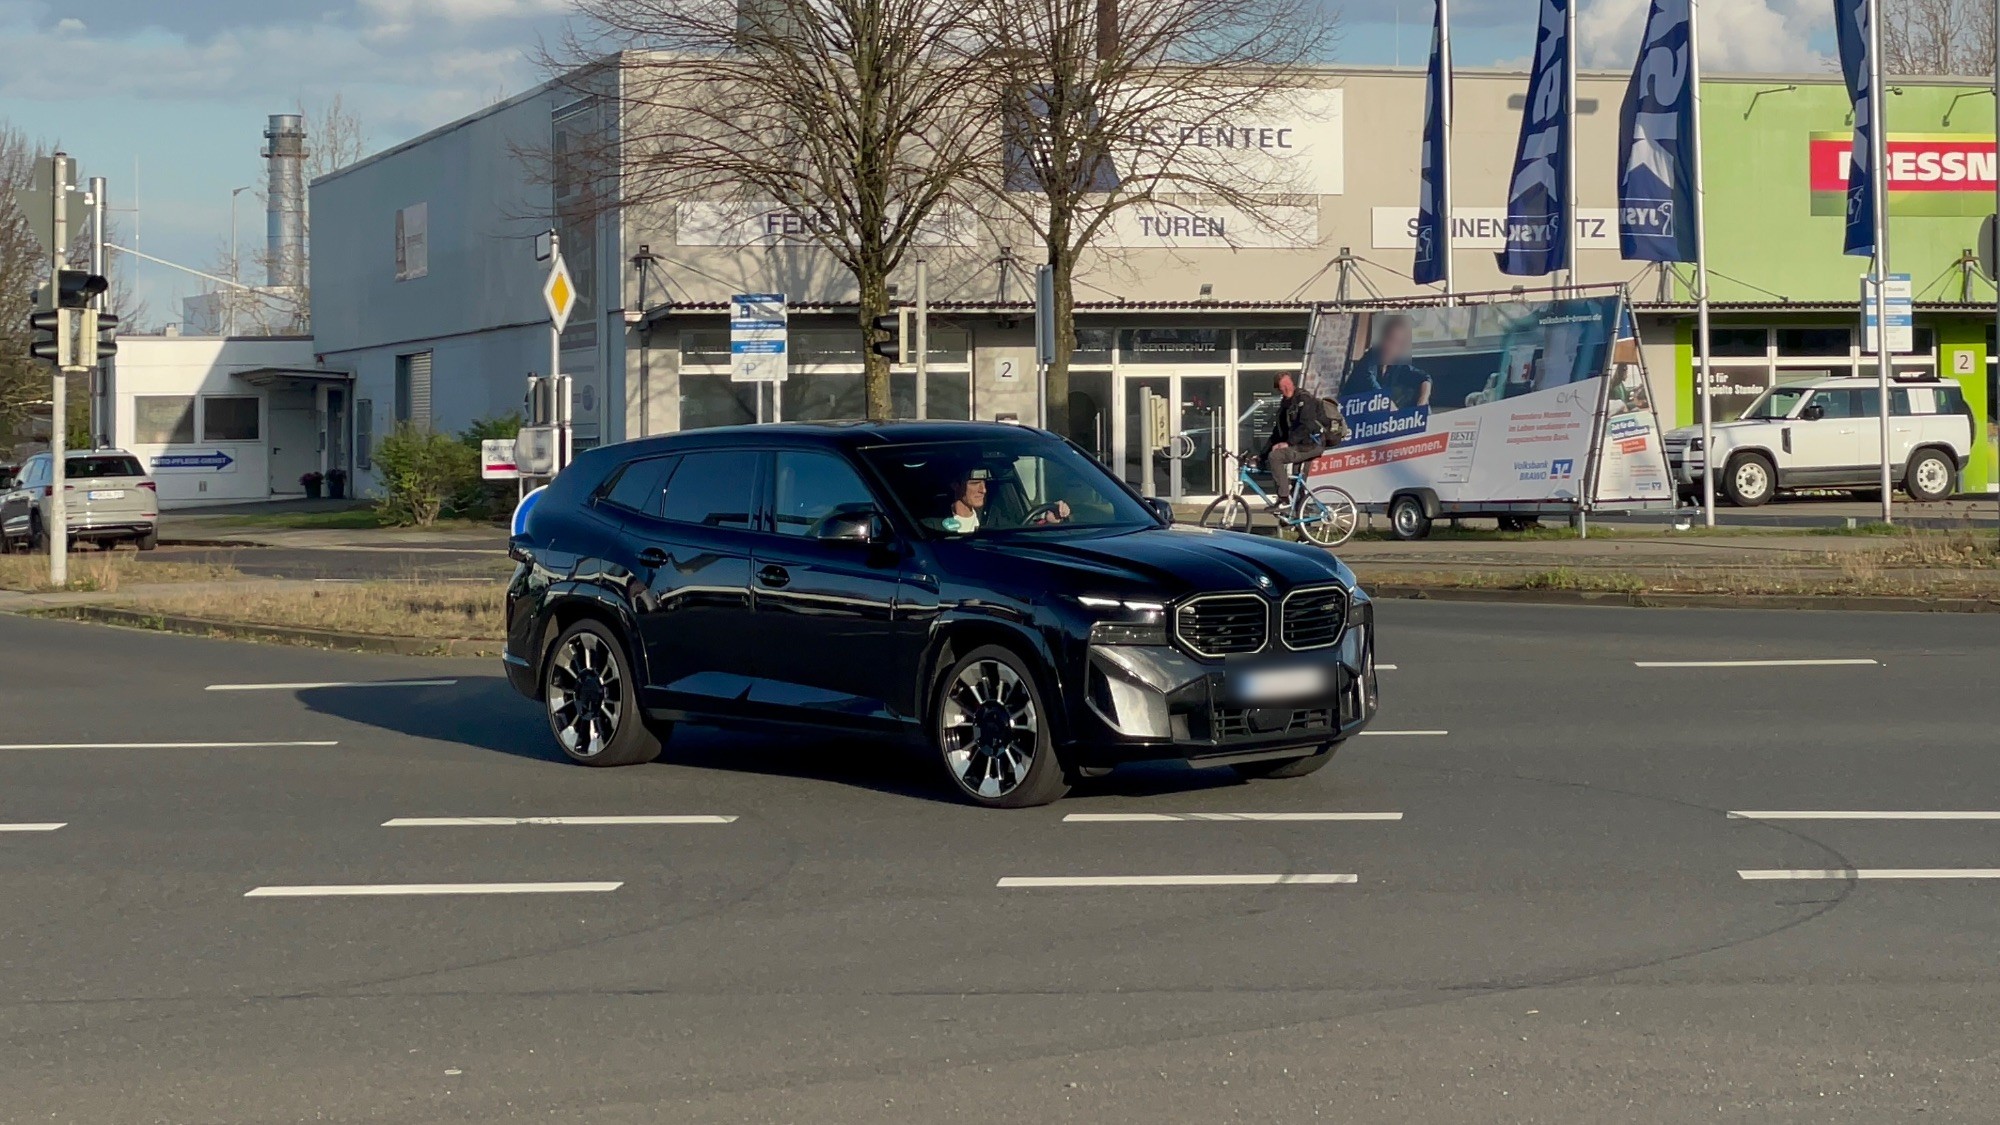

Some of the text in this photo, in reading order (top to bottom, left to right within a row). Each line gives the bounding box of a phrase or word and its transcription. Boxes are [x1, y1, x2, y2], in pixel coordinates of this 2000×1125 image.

[1139, 211, 1225, 238] TÜREN
[1000, 361, 1013, 379] 2
[1959, 354, 1969, 370] 2
[1346, 398, 1366, 416] für
[1368, 394, 1390, 412] die
[1355, 411, 1426, 439] Hausbank.
[1311, 460, 1321, 472] 3
[1329, 458, 1343, 470] im
[1344, 454, 1368, 468] Test,
[1370, 450, 1377, 463] 3
[1378, 451, 1385, 460] x
[1387, 439, 1443, 461] gewonnen.
[1514, 460, 1549, 470] Volksbank
